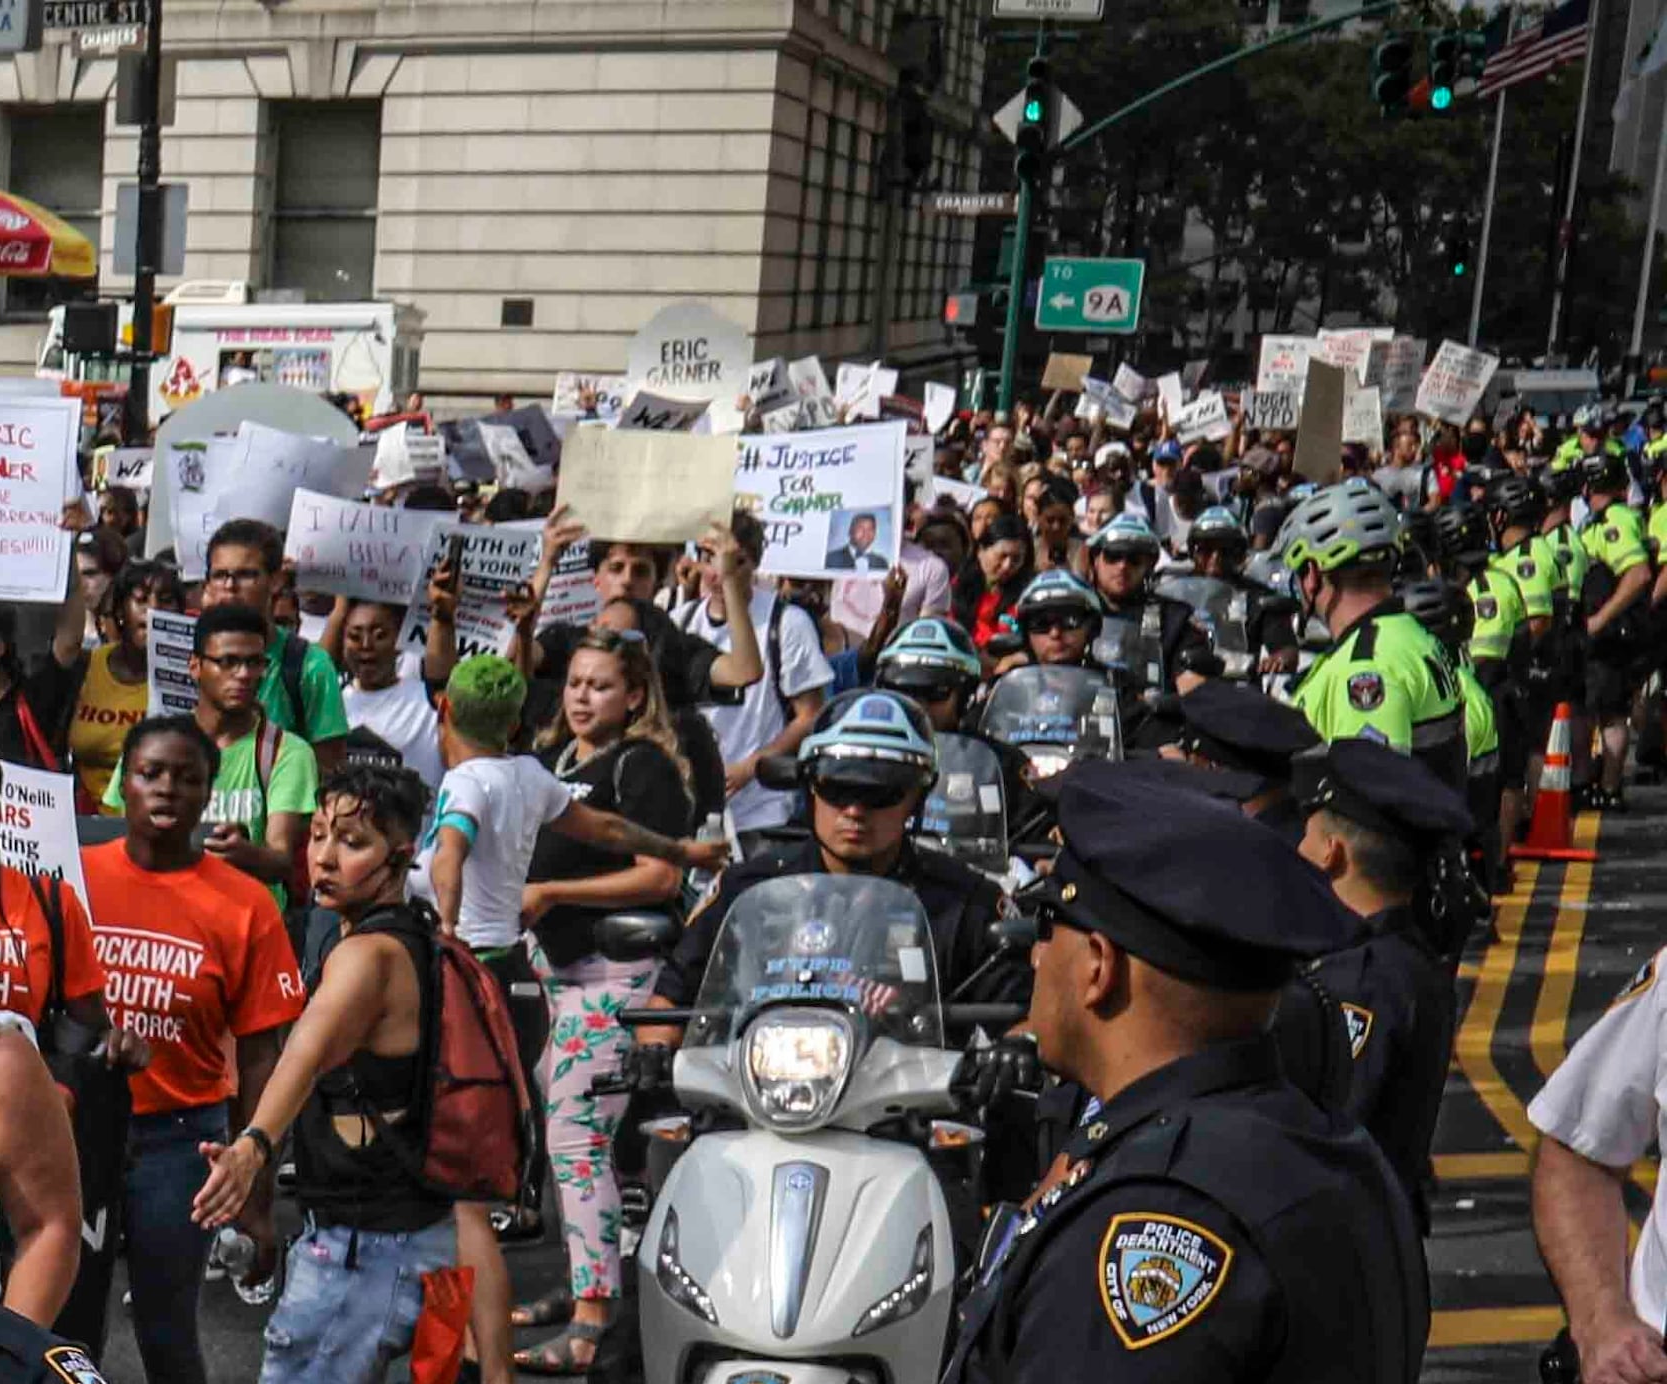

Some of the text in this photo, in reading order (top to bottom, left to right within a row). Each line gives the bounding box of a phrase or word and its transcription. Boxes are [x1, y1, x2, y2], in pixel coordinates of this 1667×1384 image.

[43, 2, 137, 24] CENTRE ST
[80, 27, 138, 47] CHAMBERS
[1052, 266, 1072, 279] TO
[1088, 291, 1122, 315] 9A
[660, 338, 708, 363] ERIC
[647, 360, 722, 385] GARNER
[767, 442, 857, 470] JUSTICE
[779, 476, 814, 498] FOR
[439, 533, 527, 557] YUTH of
[479, 558, 522, 578] YORK
[4, 782, 56, 809] O'Neill:
[0, 830, 40, 862] ting
[94, 934, 204, 981] OCKAWAY
[104, 970, 174, 1012] OUTH
[1143, 1221, 1202, 1250] POLICE
[1116, 1234, 1216, 1274] DEPARTMENT
[1106, 1262, 1129, 1321] CITY OF
[1146, 1280, 1214, 1336] NEW YORK
